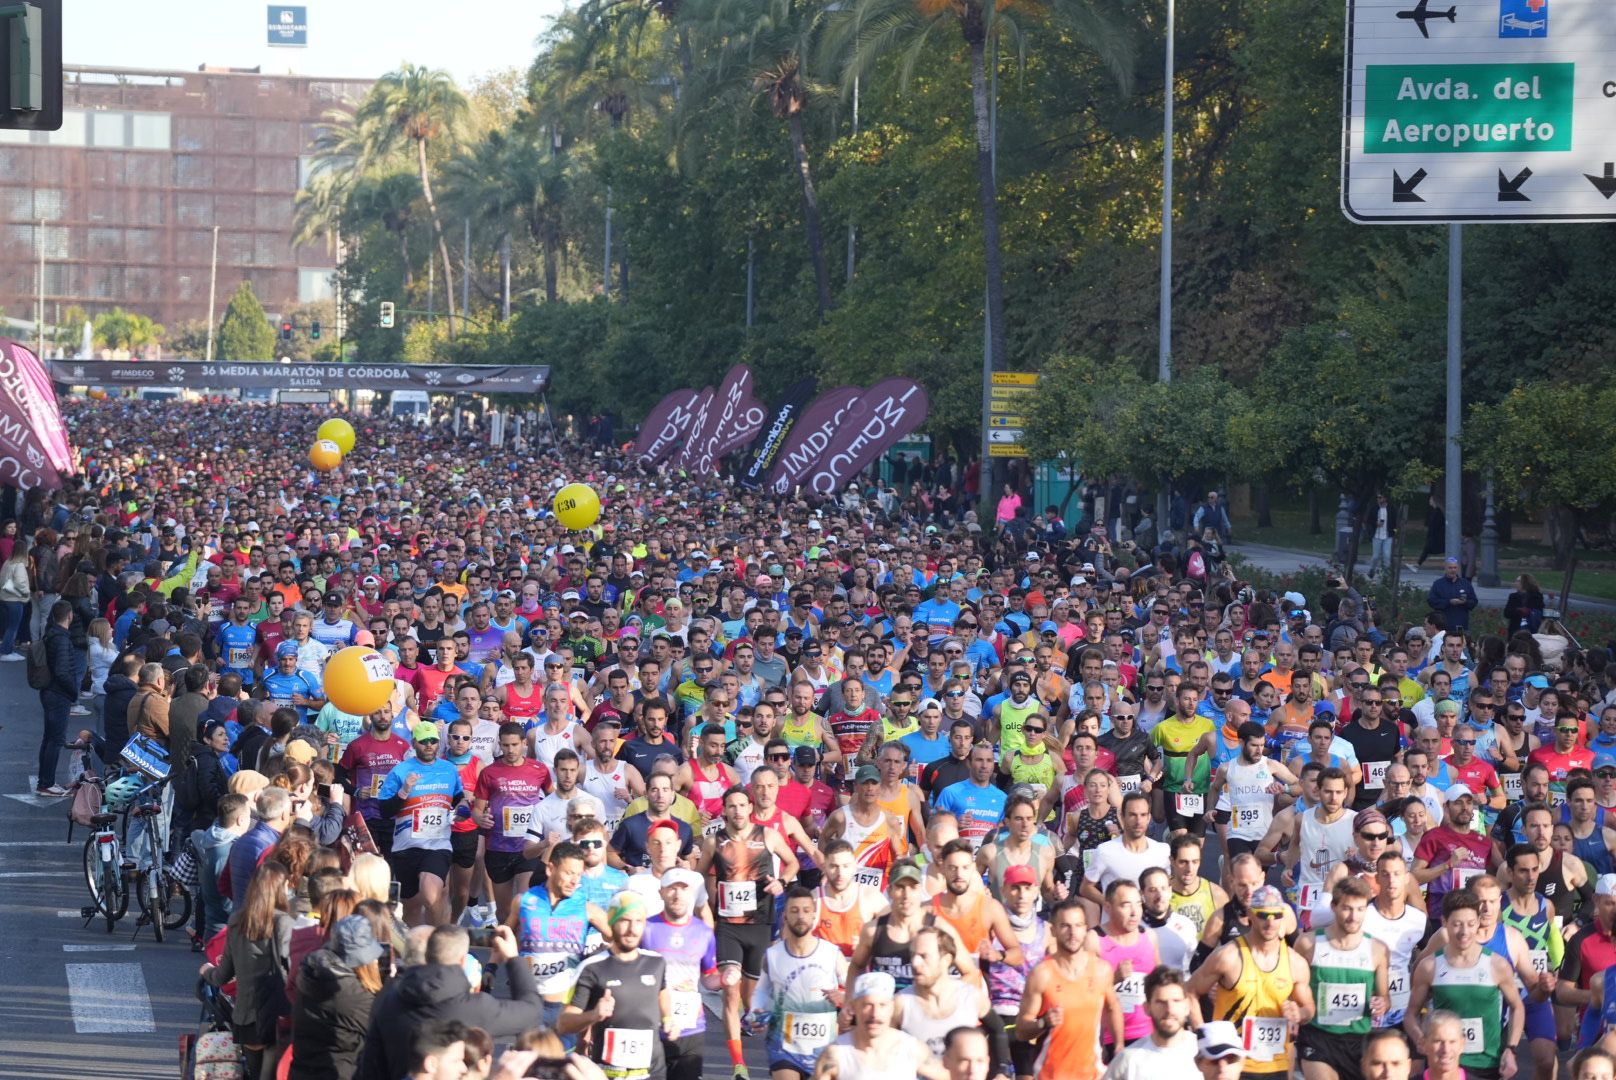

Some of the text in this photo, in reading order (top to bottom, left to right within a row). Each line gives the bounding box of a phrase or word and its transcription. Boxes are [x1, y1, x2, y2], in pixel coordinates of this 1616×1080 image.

[1397, 76, 1541, 100] Avda. del
[1382, 117, 1554, 147] Aeropuerto
[202, 365, 410, 379] 36 MEDIA MARATÓN DE CÓRDOBA
[289, 378, 322, 386] SALIDA
[557, 498, 576, 513] 1:30
[415, 783, 449, 791] enerplus
[1121, 782, 1137, 791] 901
[422, 815, 442, 826] 425
[512, 812, 532, 824] 962
[1240, 810, 1259, 820] 595
[854, 873, 879, 887] 1578
[728, 890, 750, 902] 142
[533, 960, 566, 976] 2252
[1332, 993, 1358, 1008] 453
[793, 1022, 827, 1037] 1630
[1258, 1027, 1281, 1042] 393
[621, 1040, 645, 1054] 18
